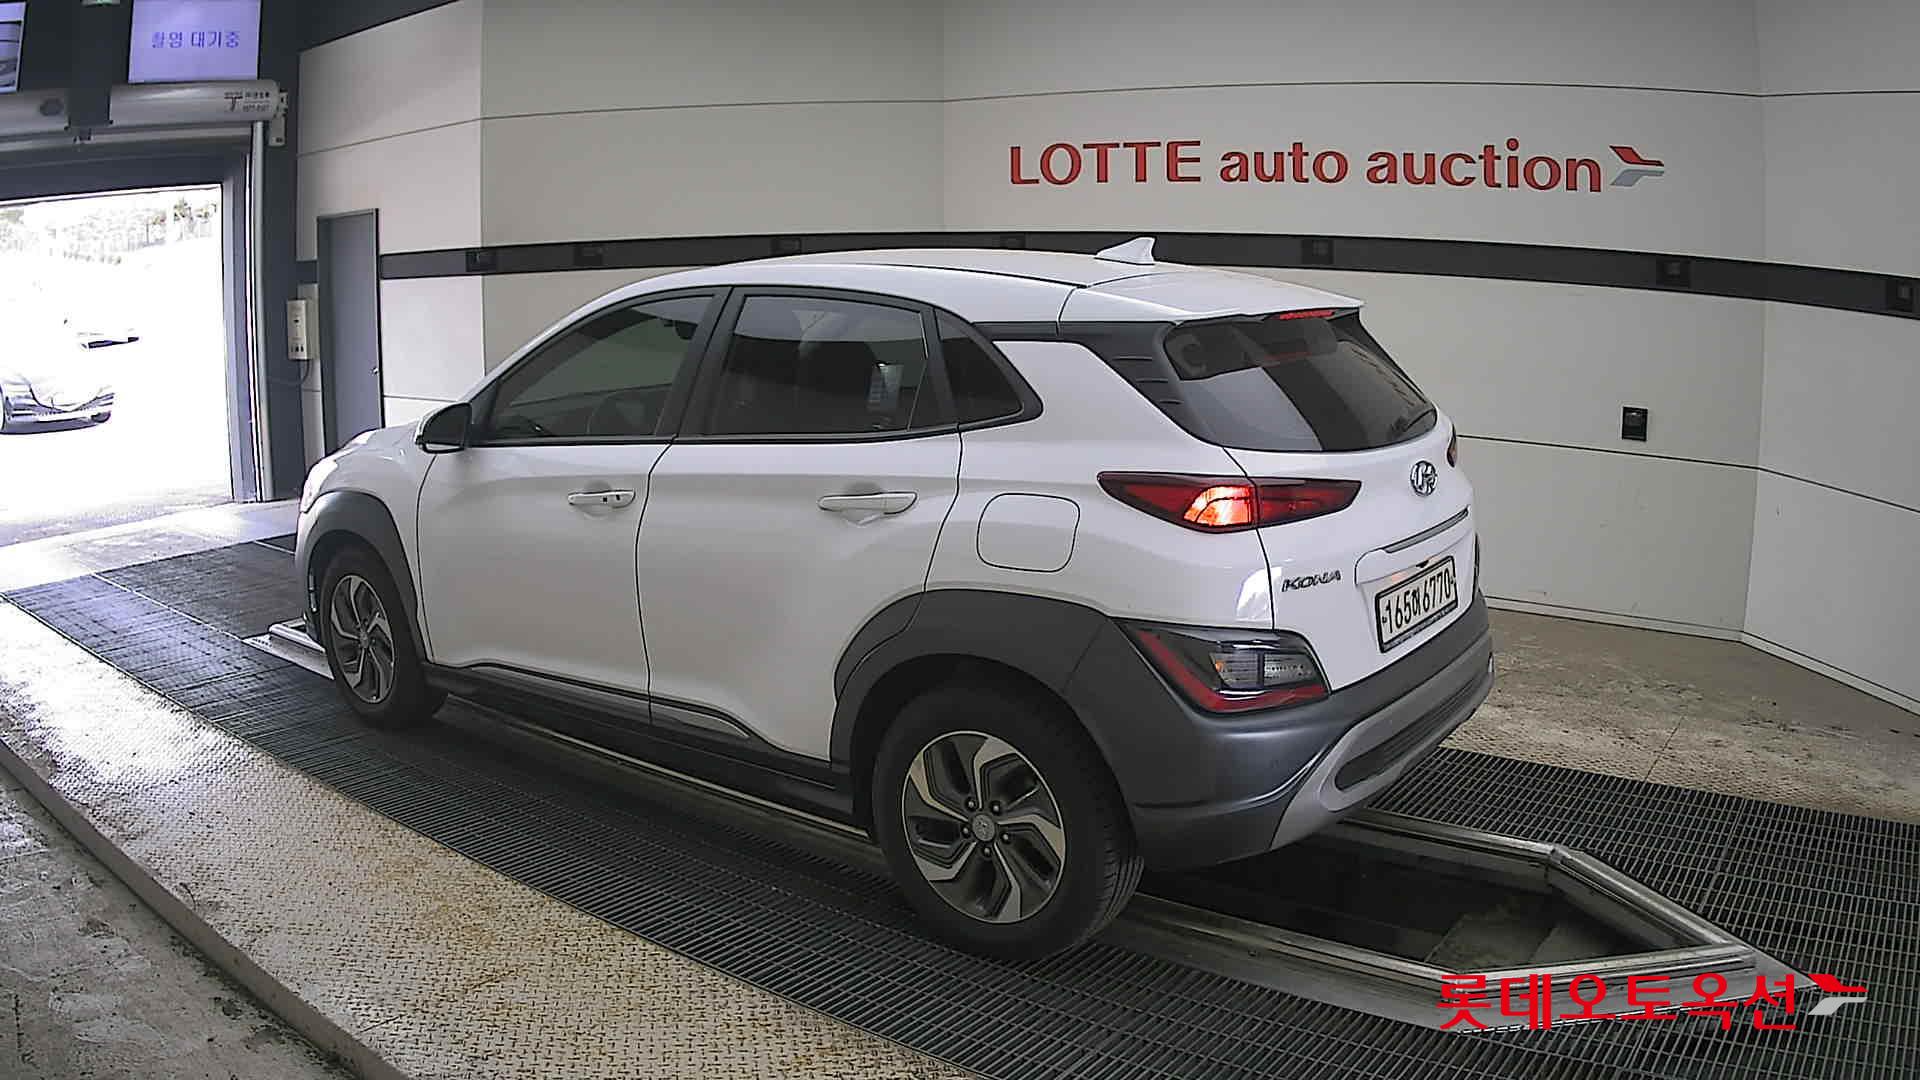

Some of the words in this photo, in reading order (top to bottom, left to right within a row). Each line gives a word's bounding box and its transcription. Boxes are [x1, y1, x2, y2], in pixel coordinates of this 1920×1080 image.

[191, 31, 240, 49] 대기중
[1009, 141, 1201, 186] LOTTE
[1219, 142, 1350, 184] auto
[1366, 138, 1602, 193] auction
[1281, 569, 1342, 593] KONA
